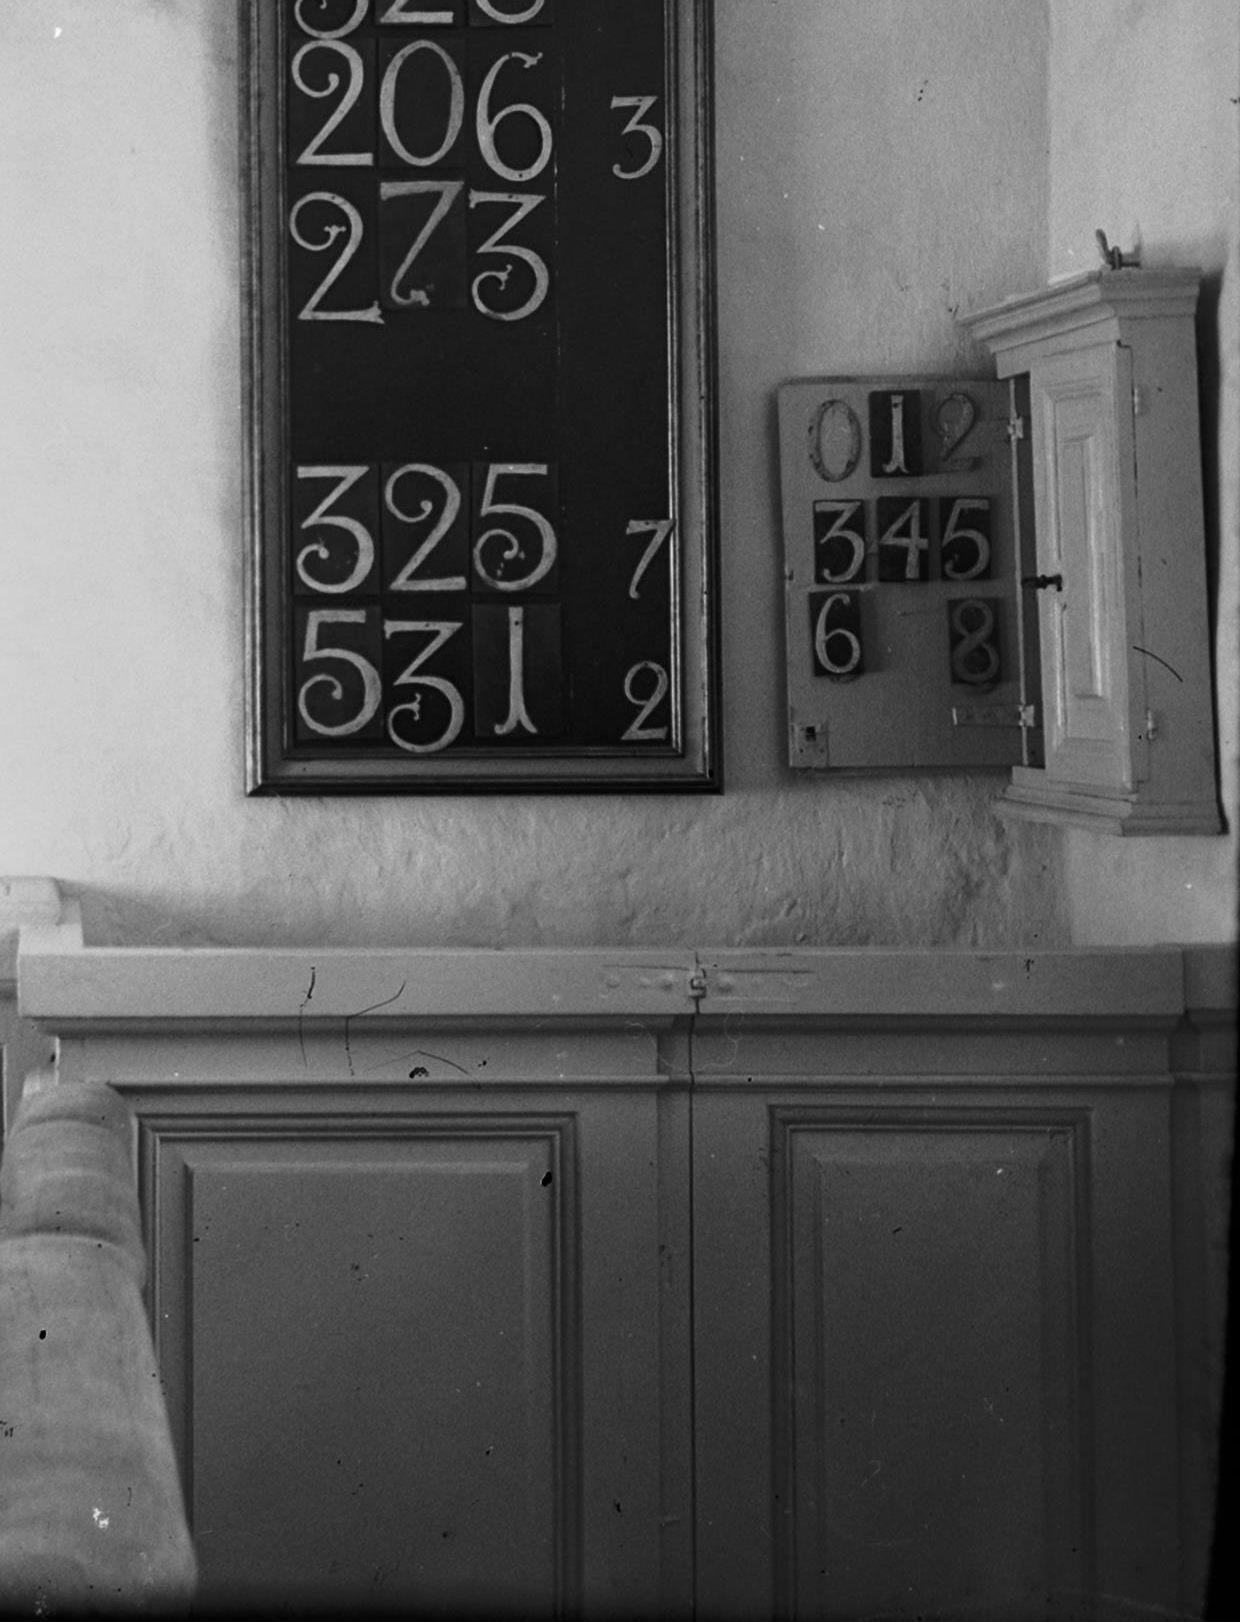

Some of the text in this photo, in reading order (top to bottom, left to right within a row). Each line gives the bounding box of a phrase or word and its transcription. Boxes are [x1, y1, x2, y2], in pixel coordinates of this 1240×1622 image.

[291, 39, 663, 182] 206 3
[289, 180, 550, 323] 273
[296, 462, 674, 599] 325 7
[297, 605, 669, 753] 531 2
[815, 592, 1000, 679] 6 8
